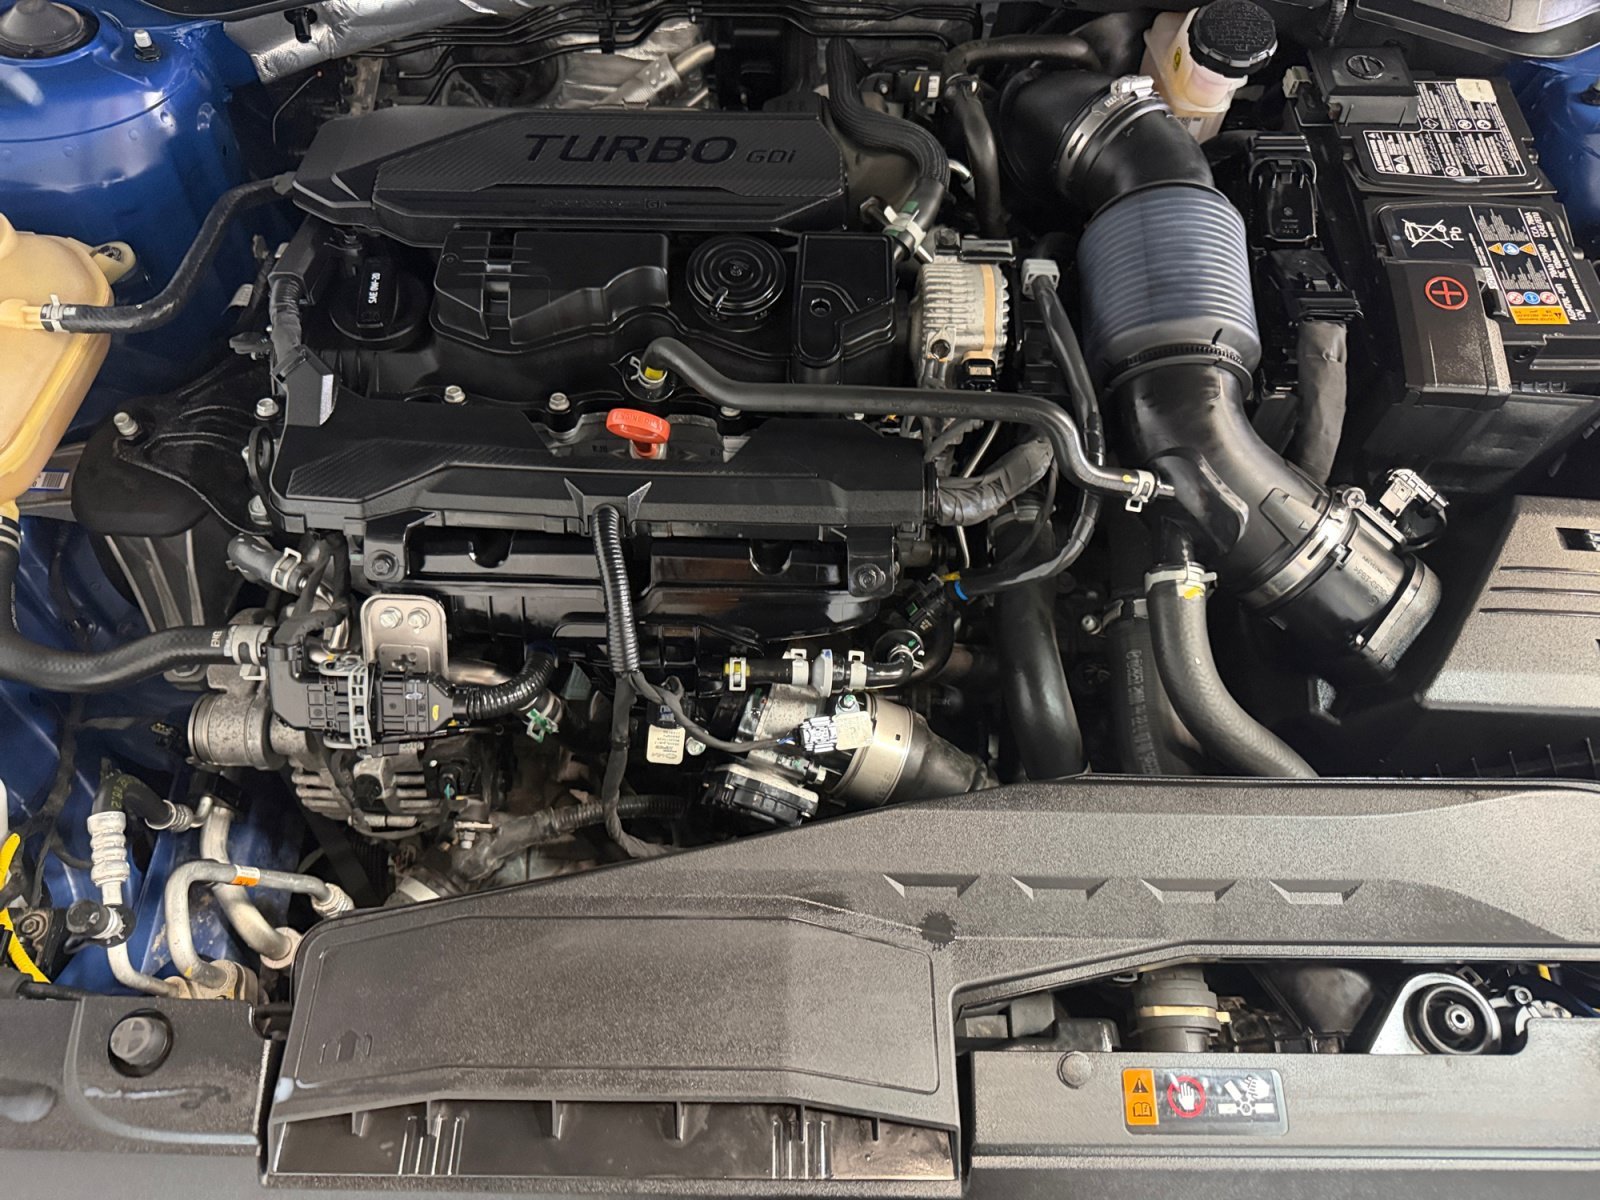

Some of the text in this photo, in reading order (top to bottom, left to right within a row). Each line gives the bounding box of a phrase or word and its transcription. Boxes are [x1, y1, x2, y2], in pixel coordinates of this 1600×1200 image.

[525, 133, 797, 165] TURBO GDi
[1449, 226, 1465, 241] Pb
[1530, 226, 1541, 238] CCA
[368, 272, 381, 304] SAE 0W-20
[1575, 308, 1587, 321] 12V
